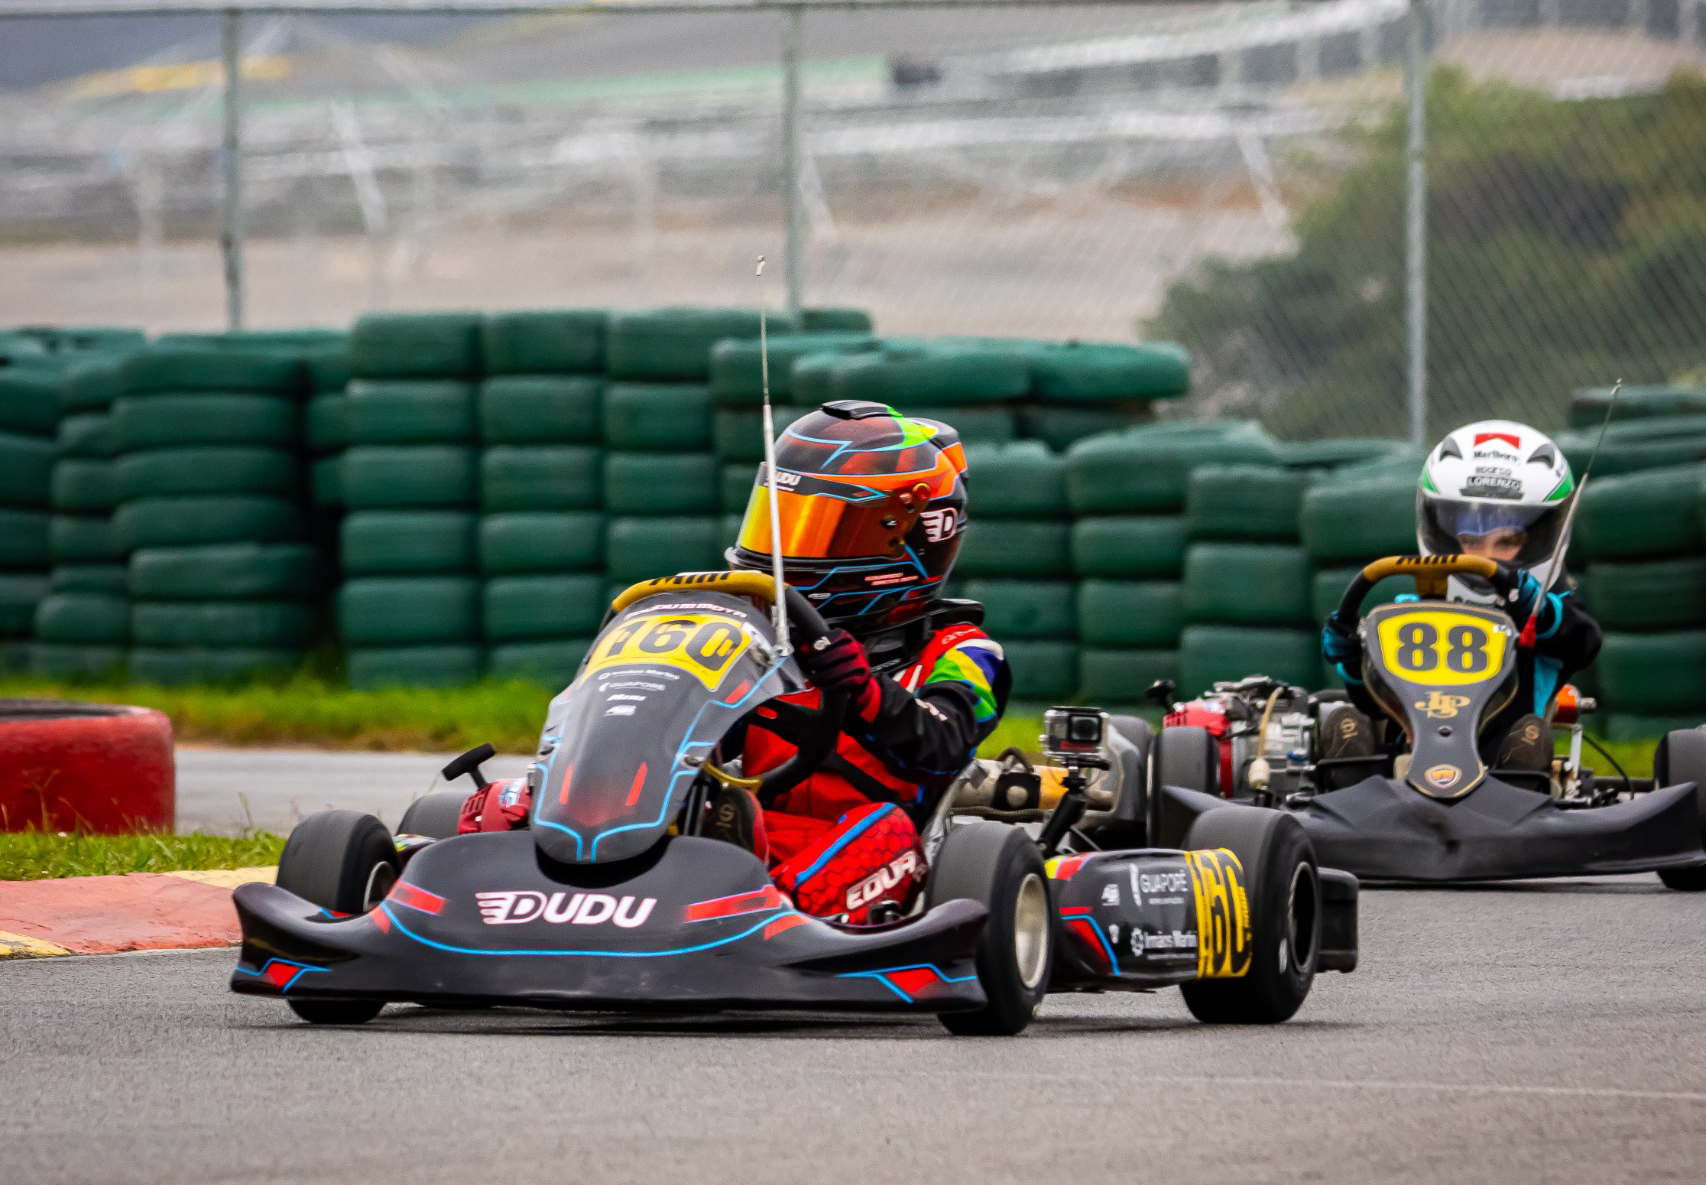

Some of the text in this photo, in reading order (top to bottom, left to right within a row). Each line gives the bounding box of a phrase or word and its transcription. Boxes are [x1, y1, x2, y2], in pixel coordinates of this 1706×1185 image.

[1468, 477, 1521, 490] LORENZO
[607, 620, 742, 671] 160
[1398, 623, 1488, 672] 88
[475, 891, 657, 928] DUDU
